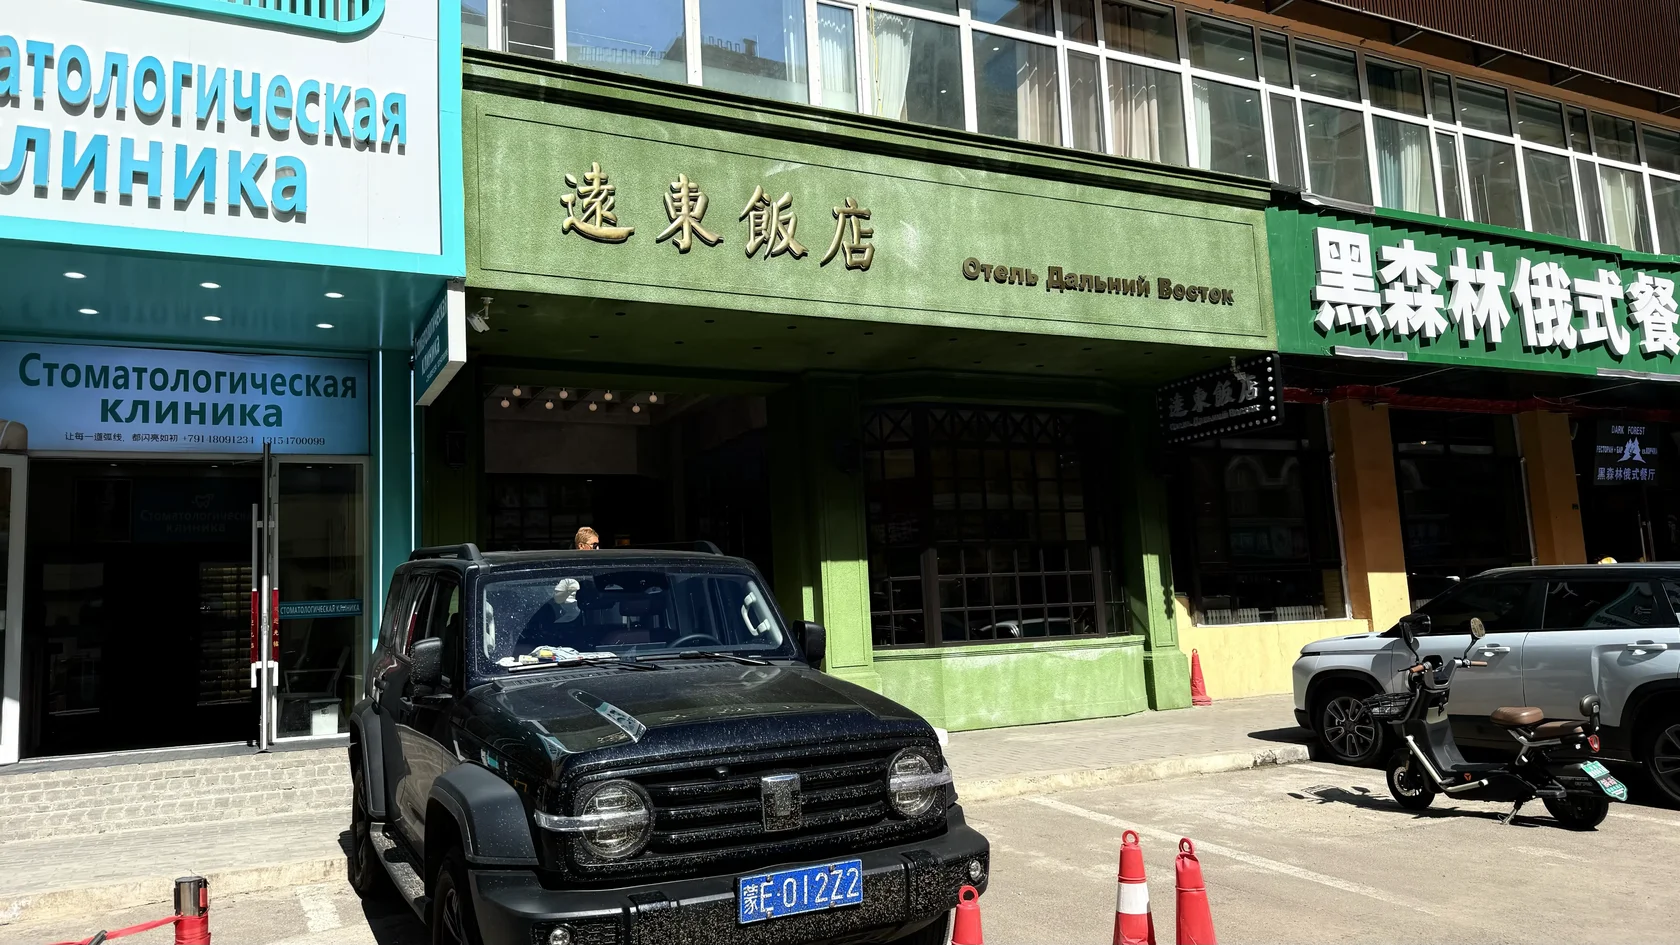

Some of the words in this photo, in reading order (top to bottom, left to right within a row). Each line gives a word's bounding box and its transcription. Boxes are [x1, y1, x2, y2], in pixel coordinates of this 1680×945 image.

[559, 161, 876, 272] 遠東飯店
[962, 257, 1039, 286] Отель
[1046, 266, 1151, 297] Дальний
[1157, 277, 1235, 306] Восток
[18, 351, 357, 400] Стоматологическая
[100, 398, 284, 428] клиника
[1611, 425, 1625, 434] DARK
[1627, 426, 1646, 436] FOREST
[1597, 467, 1656, 481] 黑森林俄式餐厅
